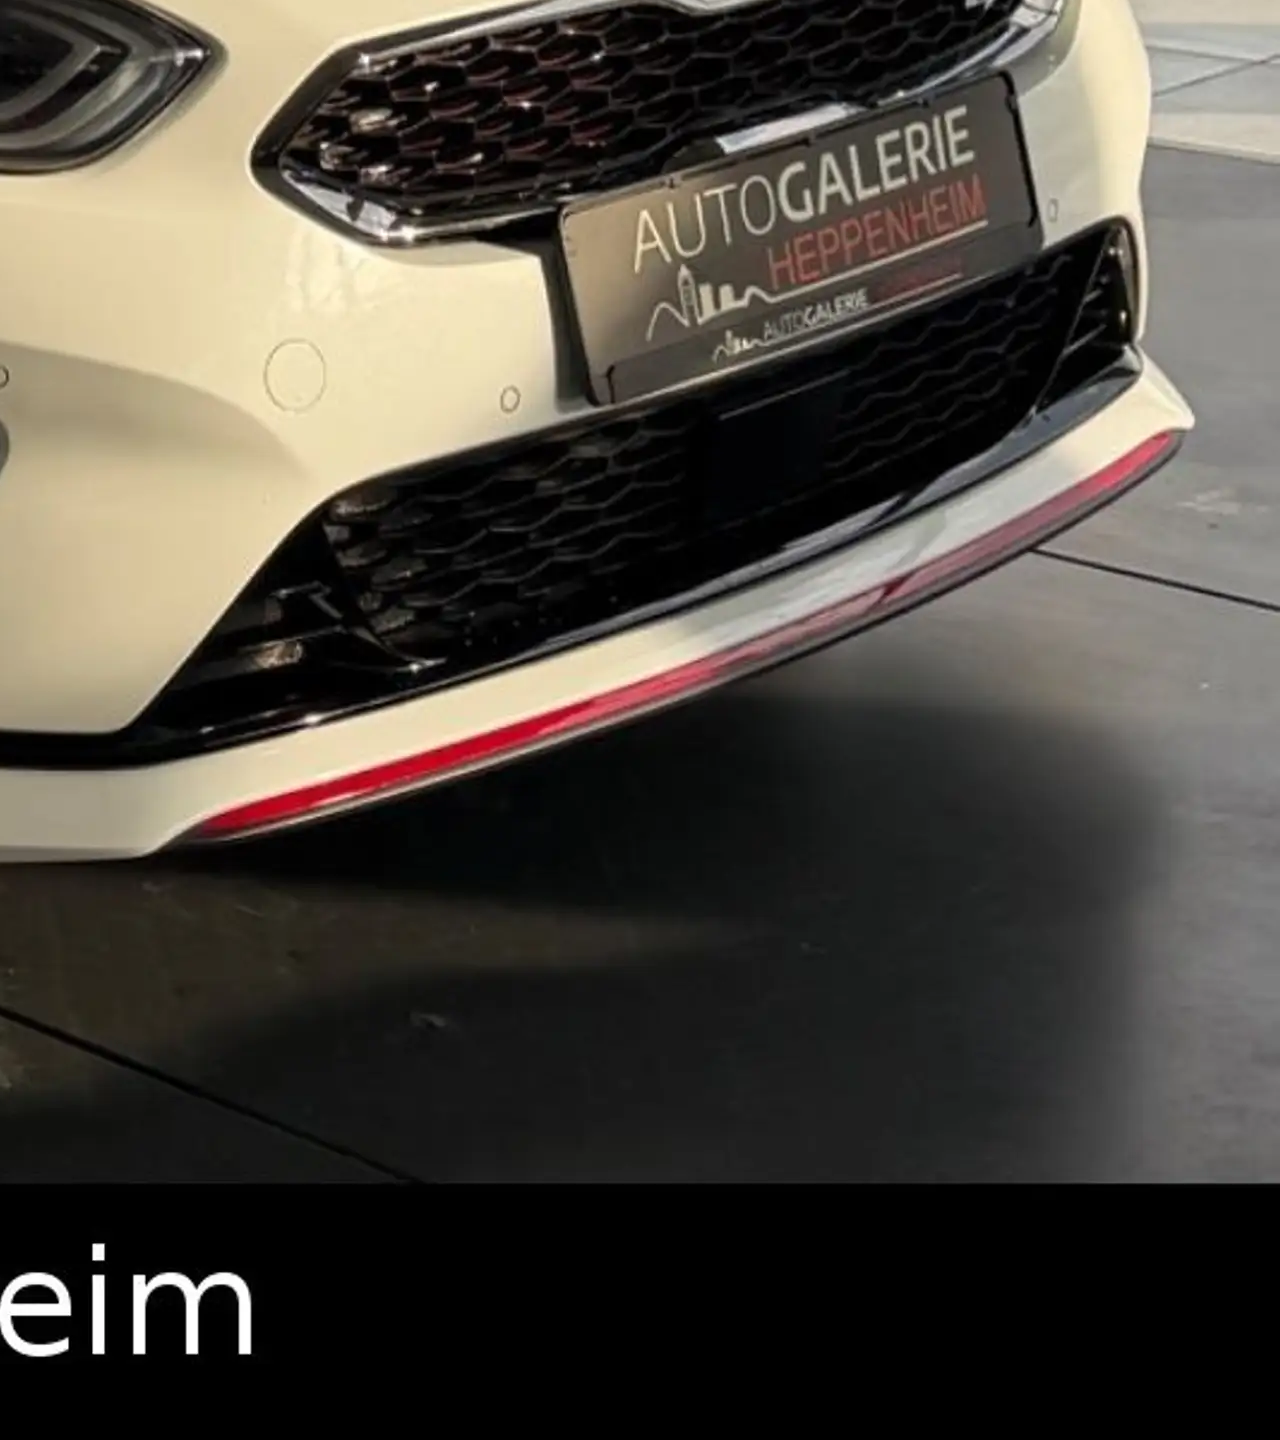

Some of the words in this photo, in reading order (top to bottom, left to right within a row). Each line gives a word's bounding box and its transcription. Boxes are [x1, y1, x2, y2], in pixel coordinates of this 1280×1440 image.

[633, 104, 975, 274] AUTOGALERIE
[766, 173, 988, 290] HEPPENHEIM
[762, 286, 870, 342] AUTOGALERIE
